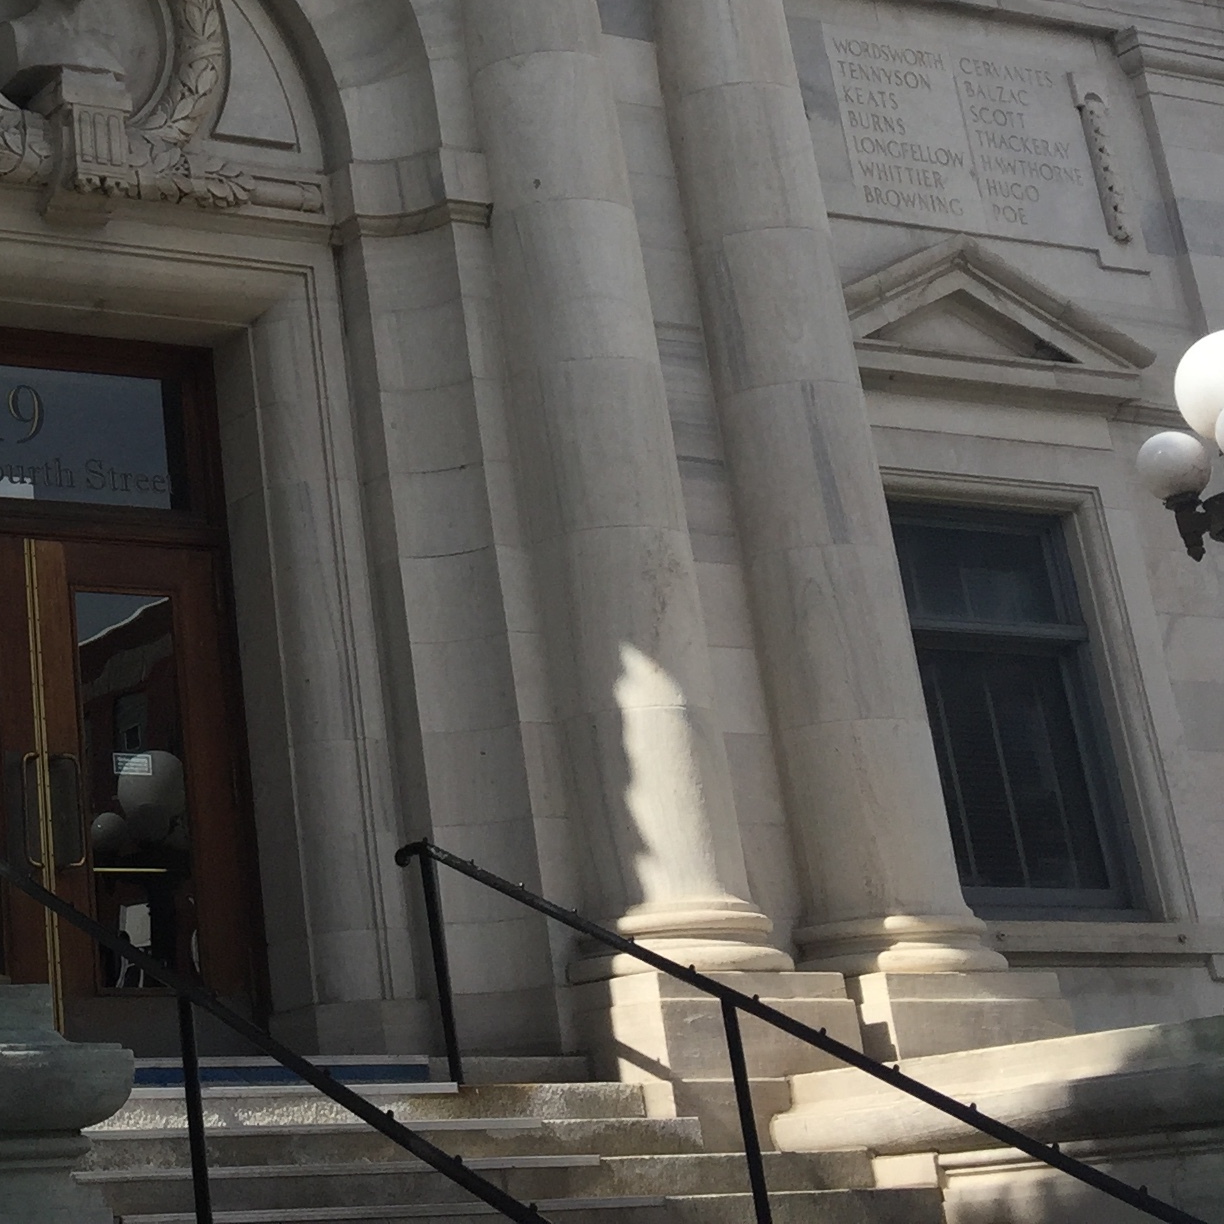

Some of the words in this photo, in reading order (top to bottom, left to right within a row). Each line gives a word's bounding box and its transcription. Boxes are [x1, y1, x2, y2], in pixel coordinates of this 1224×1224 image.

[832, 37, 945, 71] WORDSWORTH
[837, 60, 932, 91] TENNYSON
[959, 57, 1055, 88] CERVANTES
[842, 85, 898, 110] KEATS
[964, 81, 1030, 107] BALZAC
[848, 110, 906, 135] BURNS
[969, 104, 1025, 128] SCOTT
[853, 135, 965, 167] LONGFELLOW
[975, 129, 1070, 159] THACKERAY
[858, 160, 945, 189] WHITTIER
[863, 184, 965, 216] BROWNING
[986, 178, 1039, 202] HUGO
[992, 203, 1029, 225] POE
